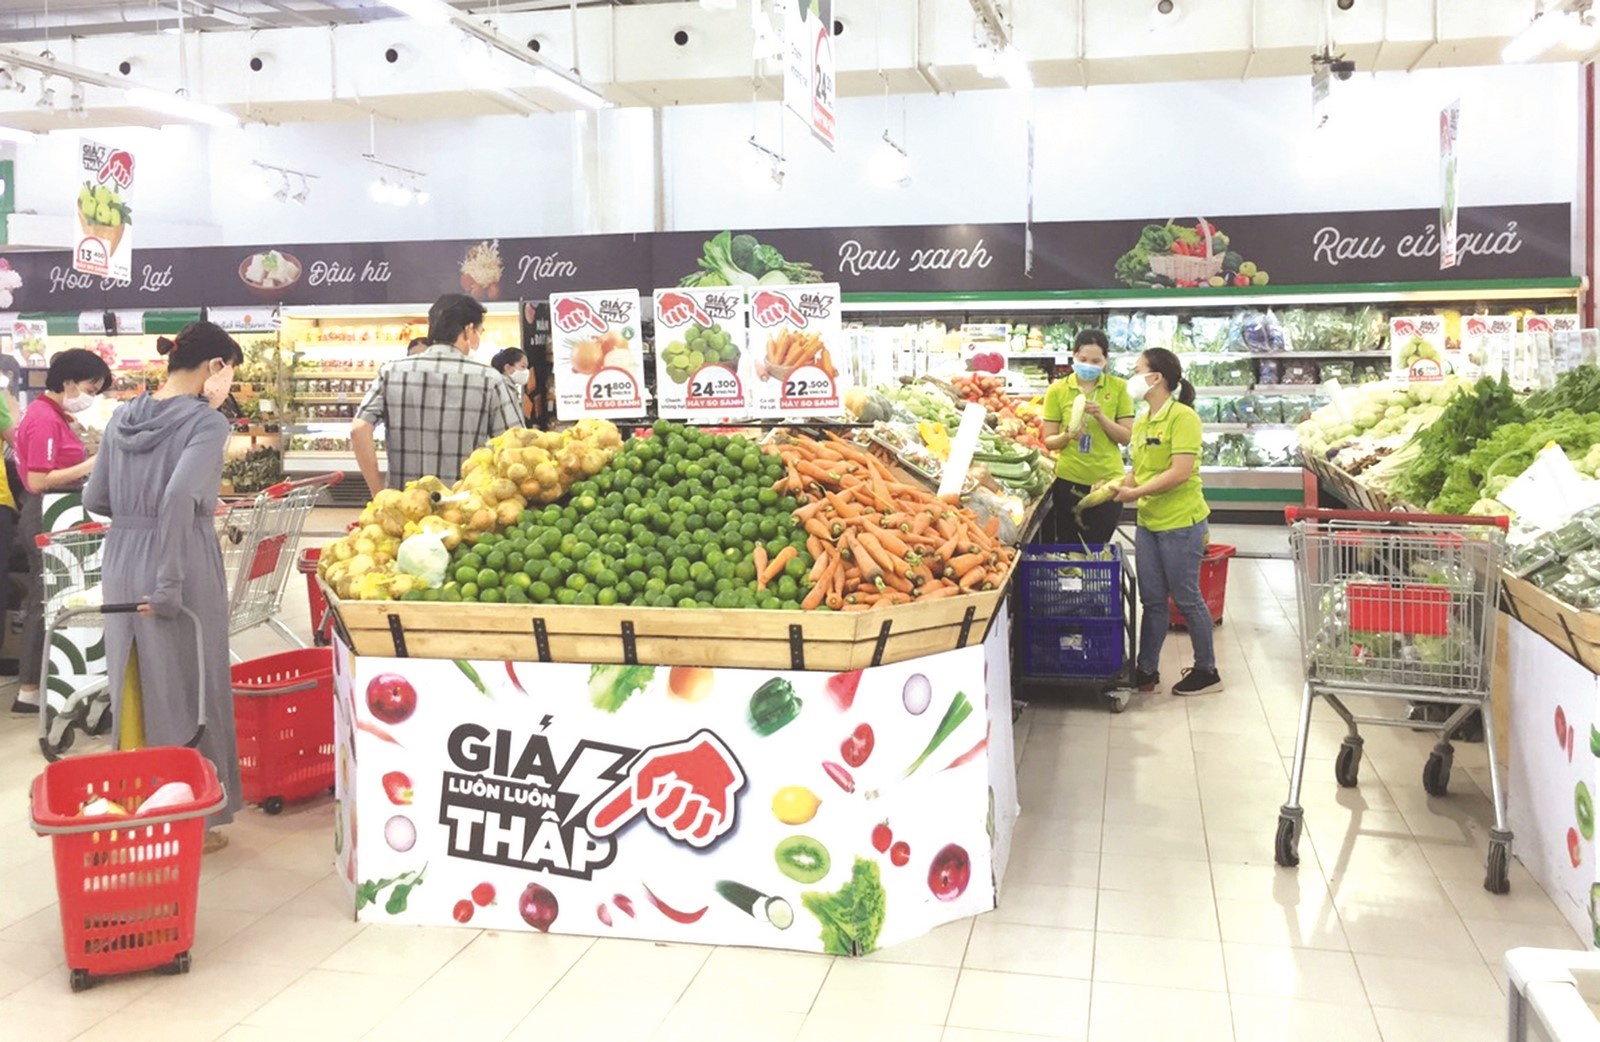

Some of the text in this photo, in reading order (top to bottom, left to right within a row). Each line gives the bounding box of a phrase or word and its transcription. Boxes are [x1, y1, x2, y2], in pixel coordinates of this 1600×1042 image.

[839, 239, 993, 276] Rau xanh
[1313, 220, 1522, 266] Rau củ quả
[49, 266, 93, 293] Hoa
[307, 260, 392, 286] Đậu hũ
[516, 252, 577, 284] Nấm
[447, 714, 558, 787] GIÁ
[449, 773, 556, 810] LUÔN LUÔN
[446, 804, 611, 873] THẤP
